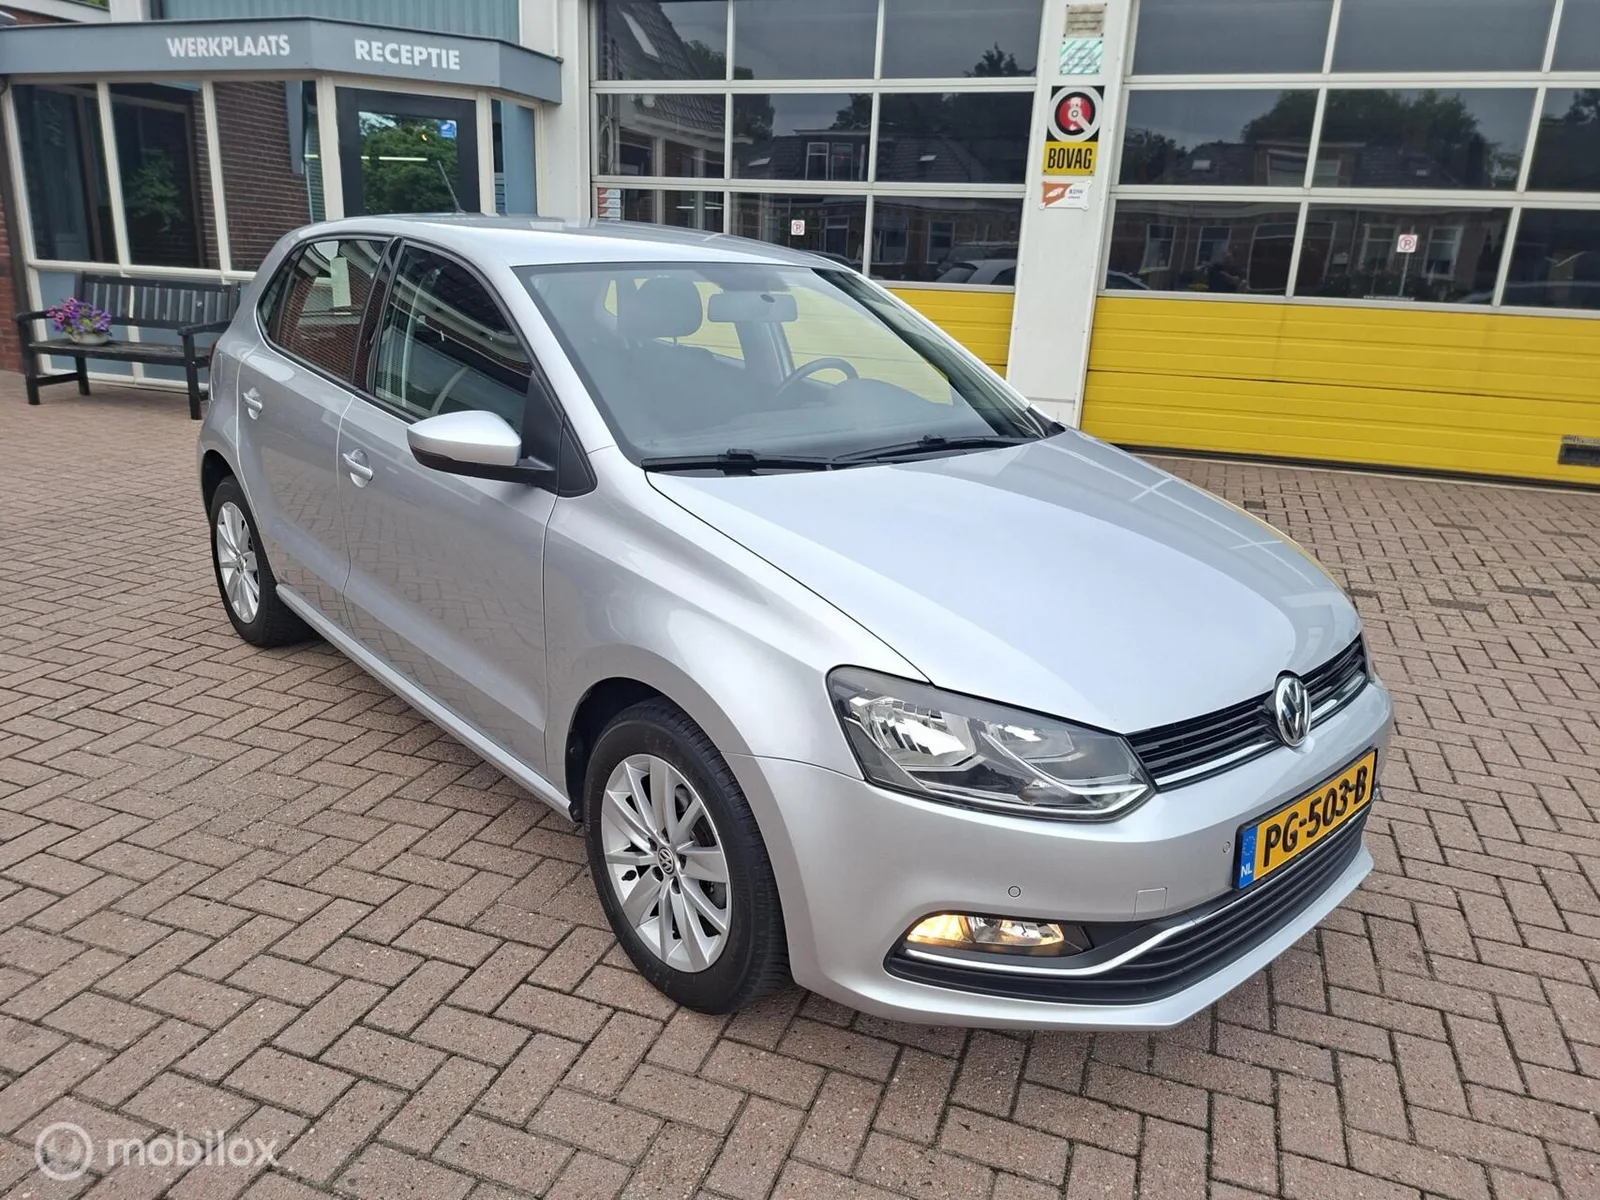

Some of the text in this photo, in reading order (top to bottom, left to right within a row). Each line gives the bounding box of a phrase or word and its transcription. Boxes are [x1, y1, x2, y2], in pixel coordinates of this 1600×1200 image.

[166, 35, 290, 58] WERKPLAATS
[354, 39, 461, 70] RECEPTIE
[1047, 147, 1093, 170] BOVAG
[1263, 765, 1368, 868] PG-503-B
[1240, 863, 1253, 878] NL
